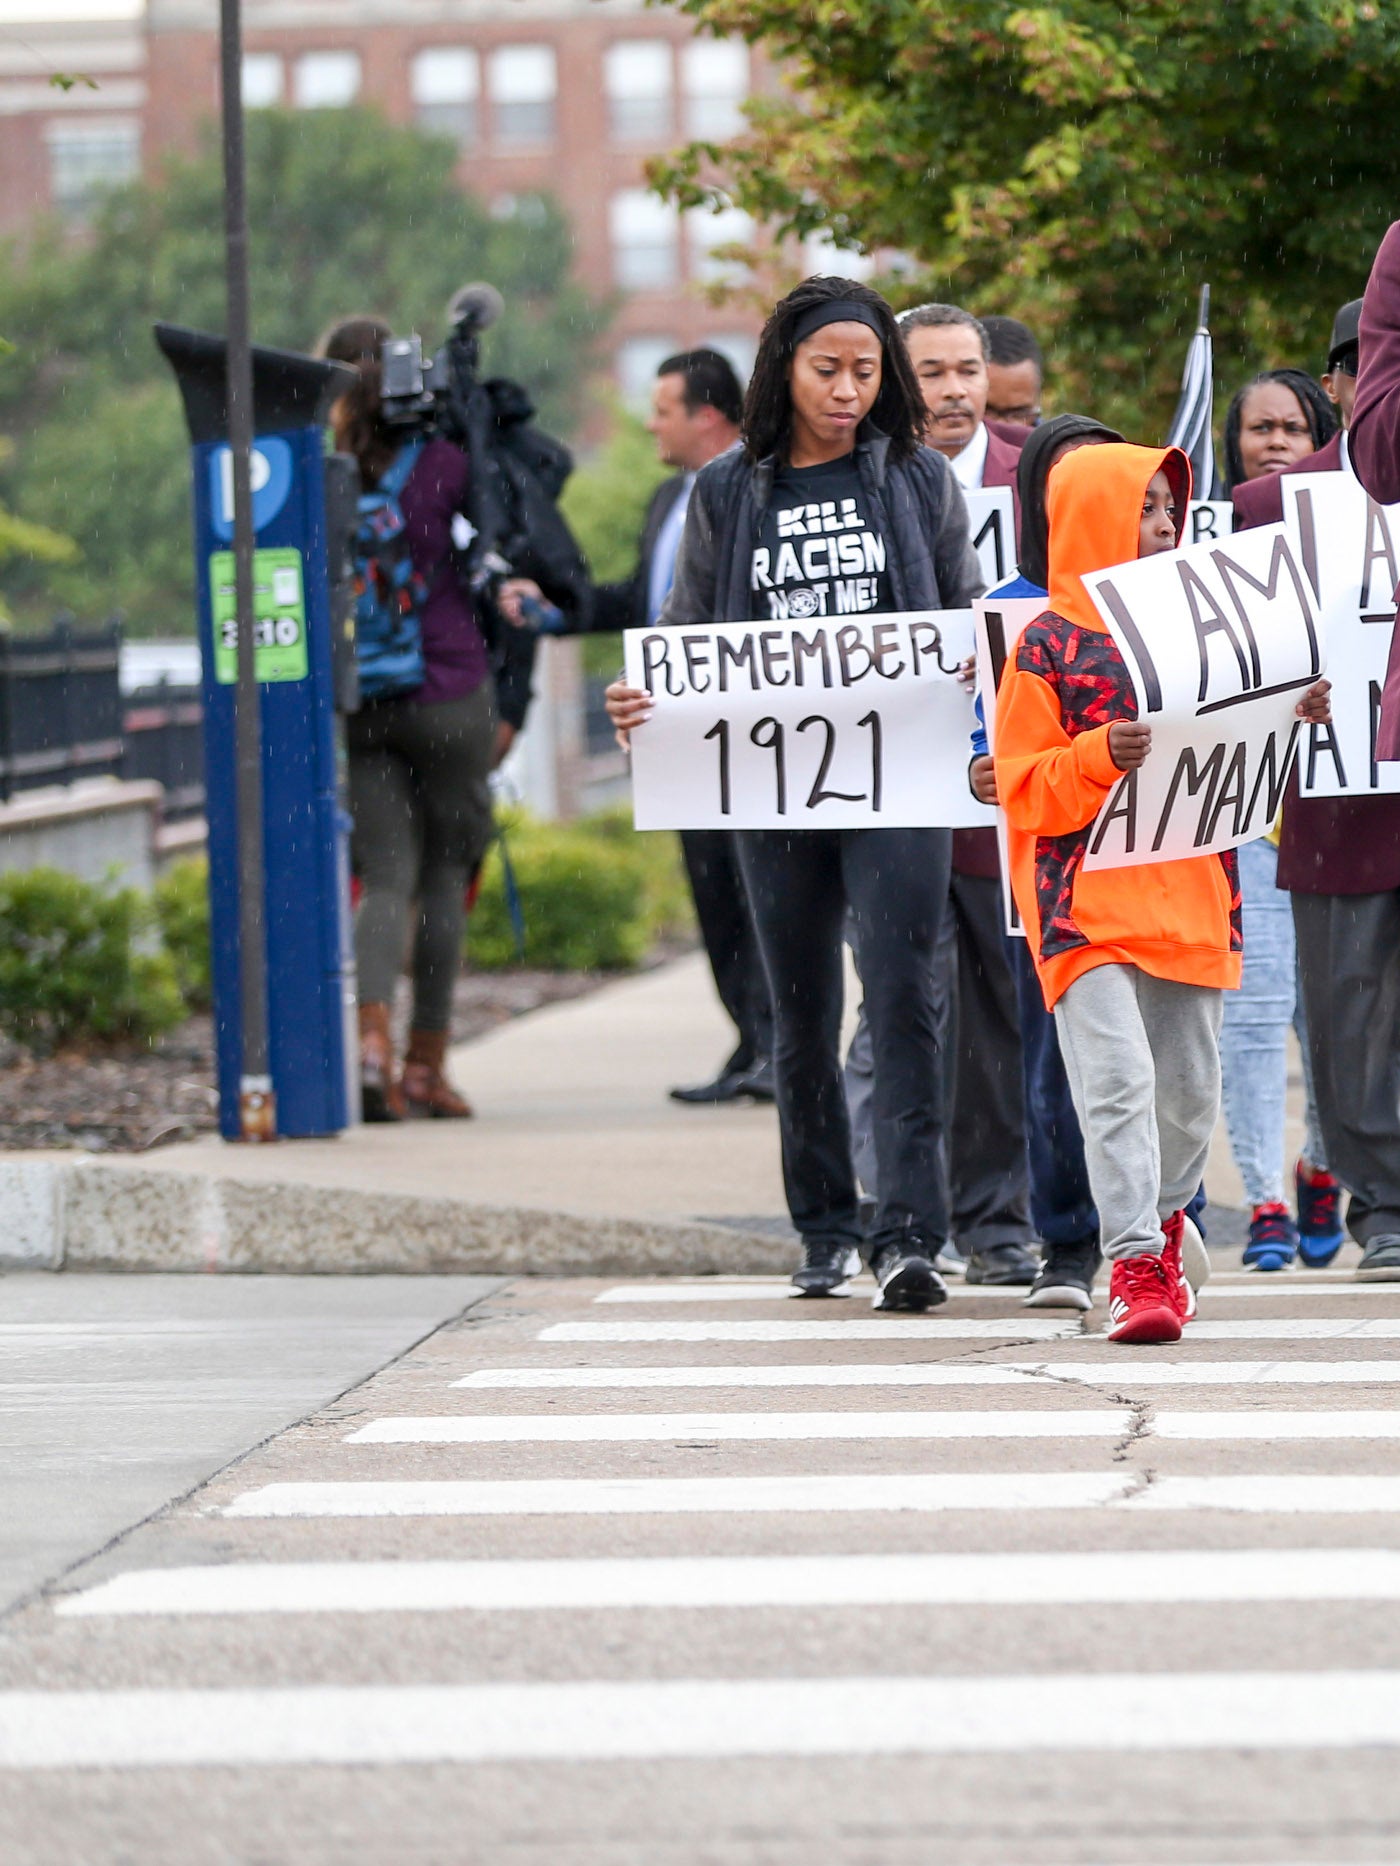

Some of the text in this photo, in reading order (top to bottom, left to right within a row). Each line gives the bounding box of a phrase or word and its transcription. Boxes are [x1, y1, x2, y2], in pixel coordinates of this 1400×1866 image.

[777, 498, 866, 538] KILL
[766, 577, 879, 620] NOT ME!
[1095, 534, 1321, 713] I AM
[642, 621, 962, 697] REMEMBER
[704, 709, 883, 815] 1921
[1090, 768, 1138, 855] A
[1151, 720, 1303, 852] MAN
